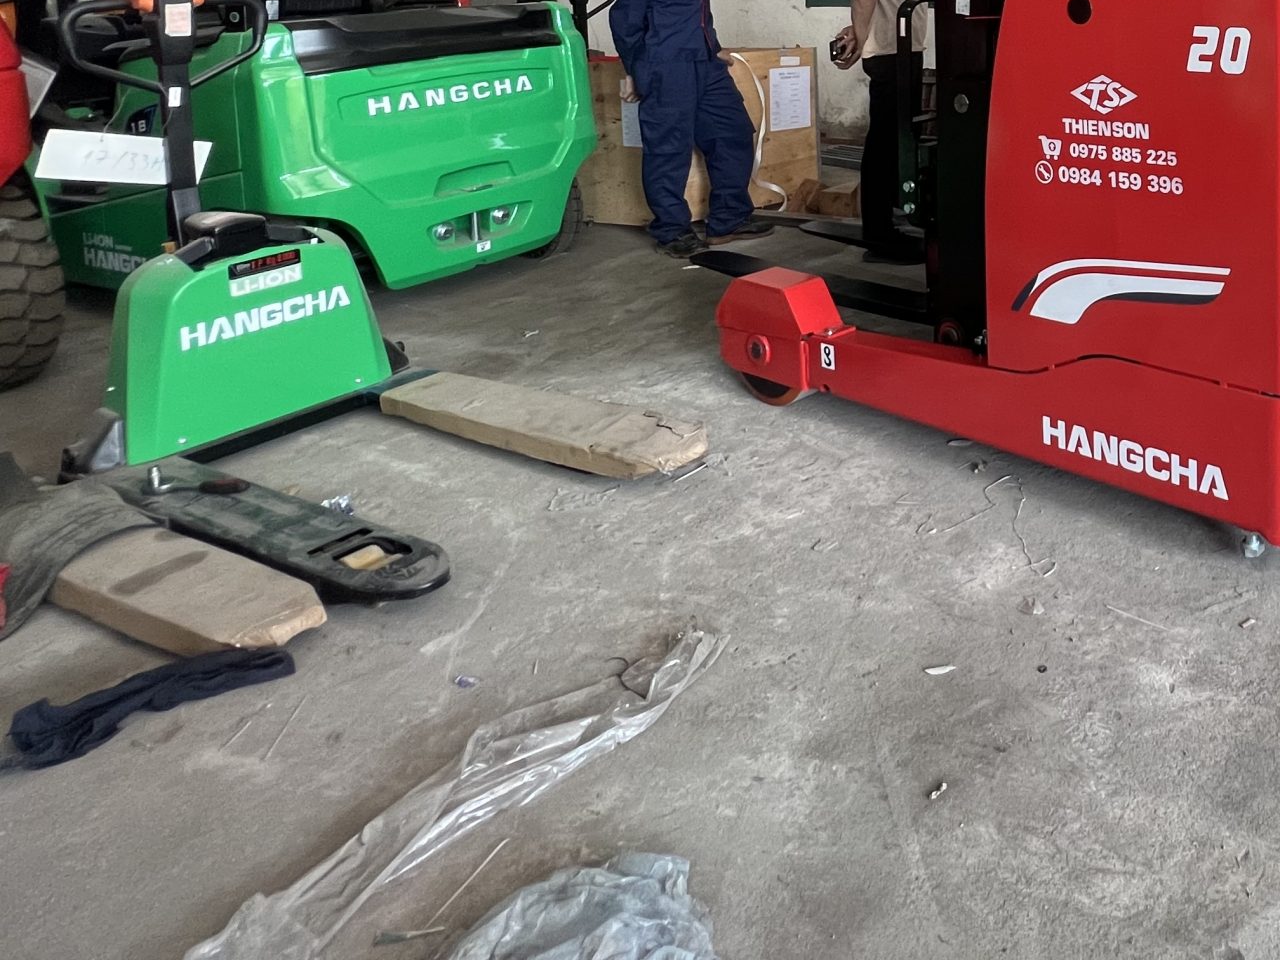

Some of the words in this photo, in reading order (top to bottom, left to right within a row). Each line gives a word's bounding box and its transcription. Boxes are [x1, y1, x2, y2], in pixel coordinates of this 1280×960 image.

[1186, 25, 1252, 75] 20
[367, 75, 533, 116] HANGCHA
[1081, 79, 1126, 113] TS
[1062, 117, 1150, 140] THIENSON
[1069, 143, 1107, 161] 0975
[1111, 146, 1142, 164] 885
[1146, 149, 1178, 167] 225
[1058, 166, 1102, 187] 0984
[1108, 171, 1142, 191] 159
[1147, 175, 1184, 196] 396
[83, 246, 146, 273] HANGC
[230, 263, 303, 297] LI-ION
[180, 285, 351, 352] HANGCHA
[1042, 415, 1229, 501] HANGCHA
